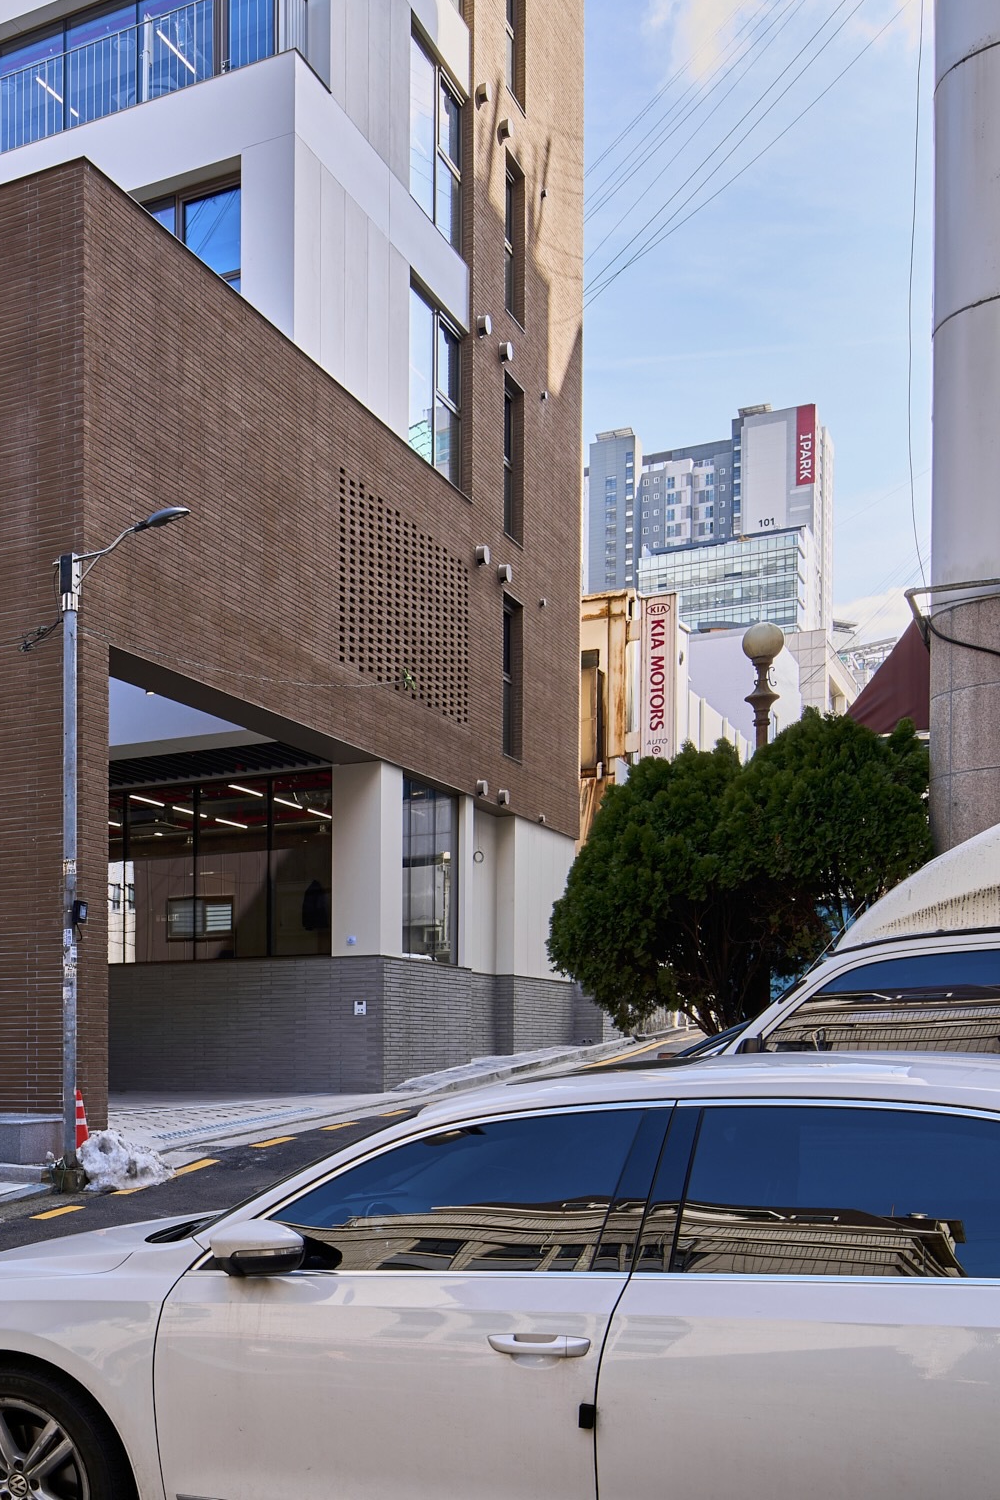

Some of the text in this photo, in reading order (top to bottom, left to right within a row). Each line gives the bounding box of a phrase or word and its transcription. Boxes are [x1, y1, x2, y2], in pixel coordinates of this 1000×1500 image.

[799, 432, 812, 481] IPARK
[758, 517, 775, 528] 101
[650, 605, 666, 614] KIA
[649, 618, 665, 732] KIA MOTORS
[646, 737, 669, 746] AUTO
